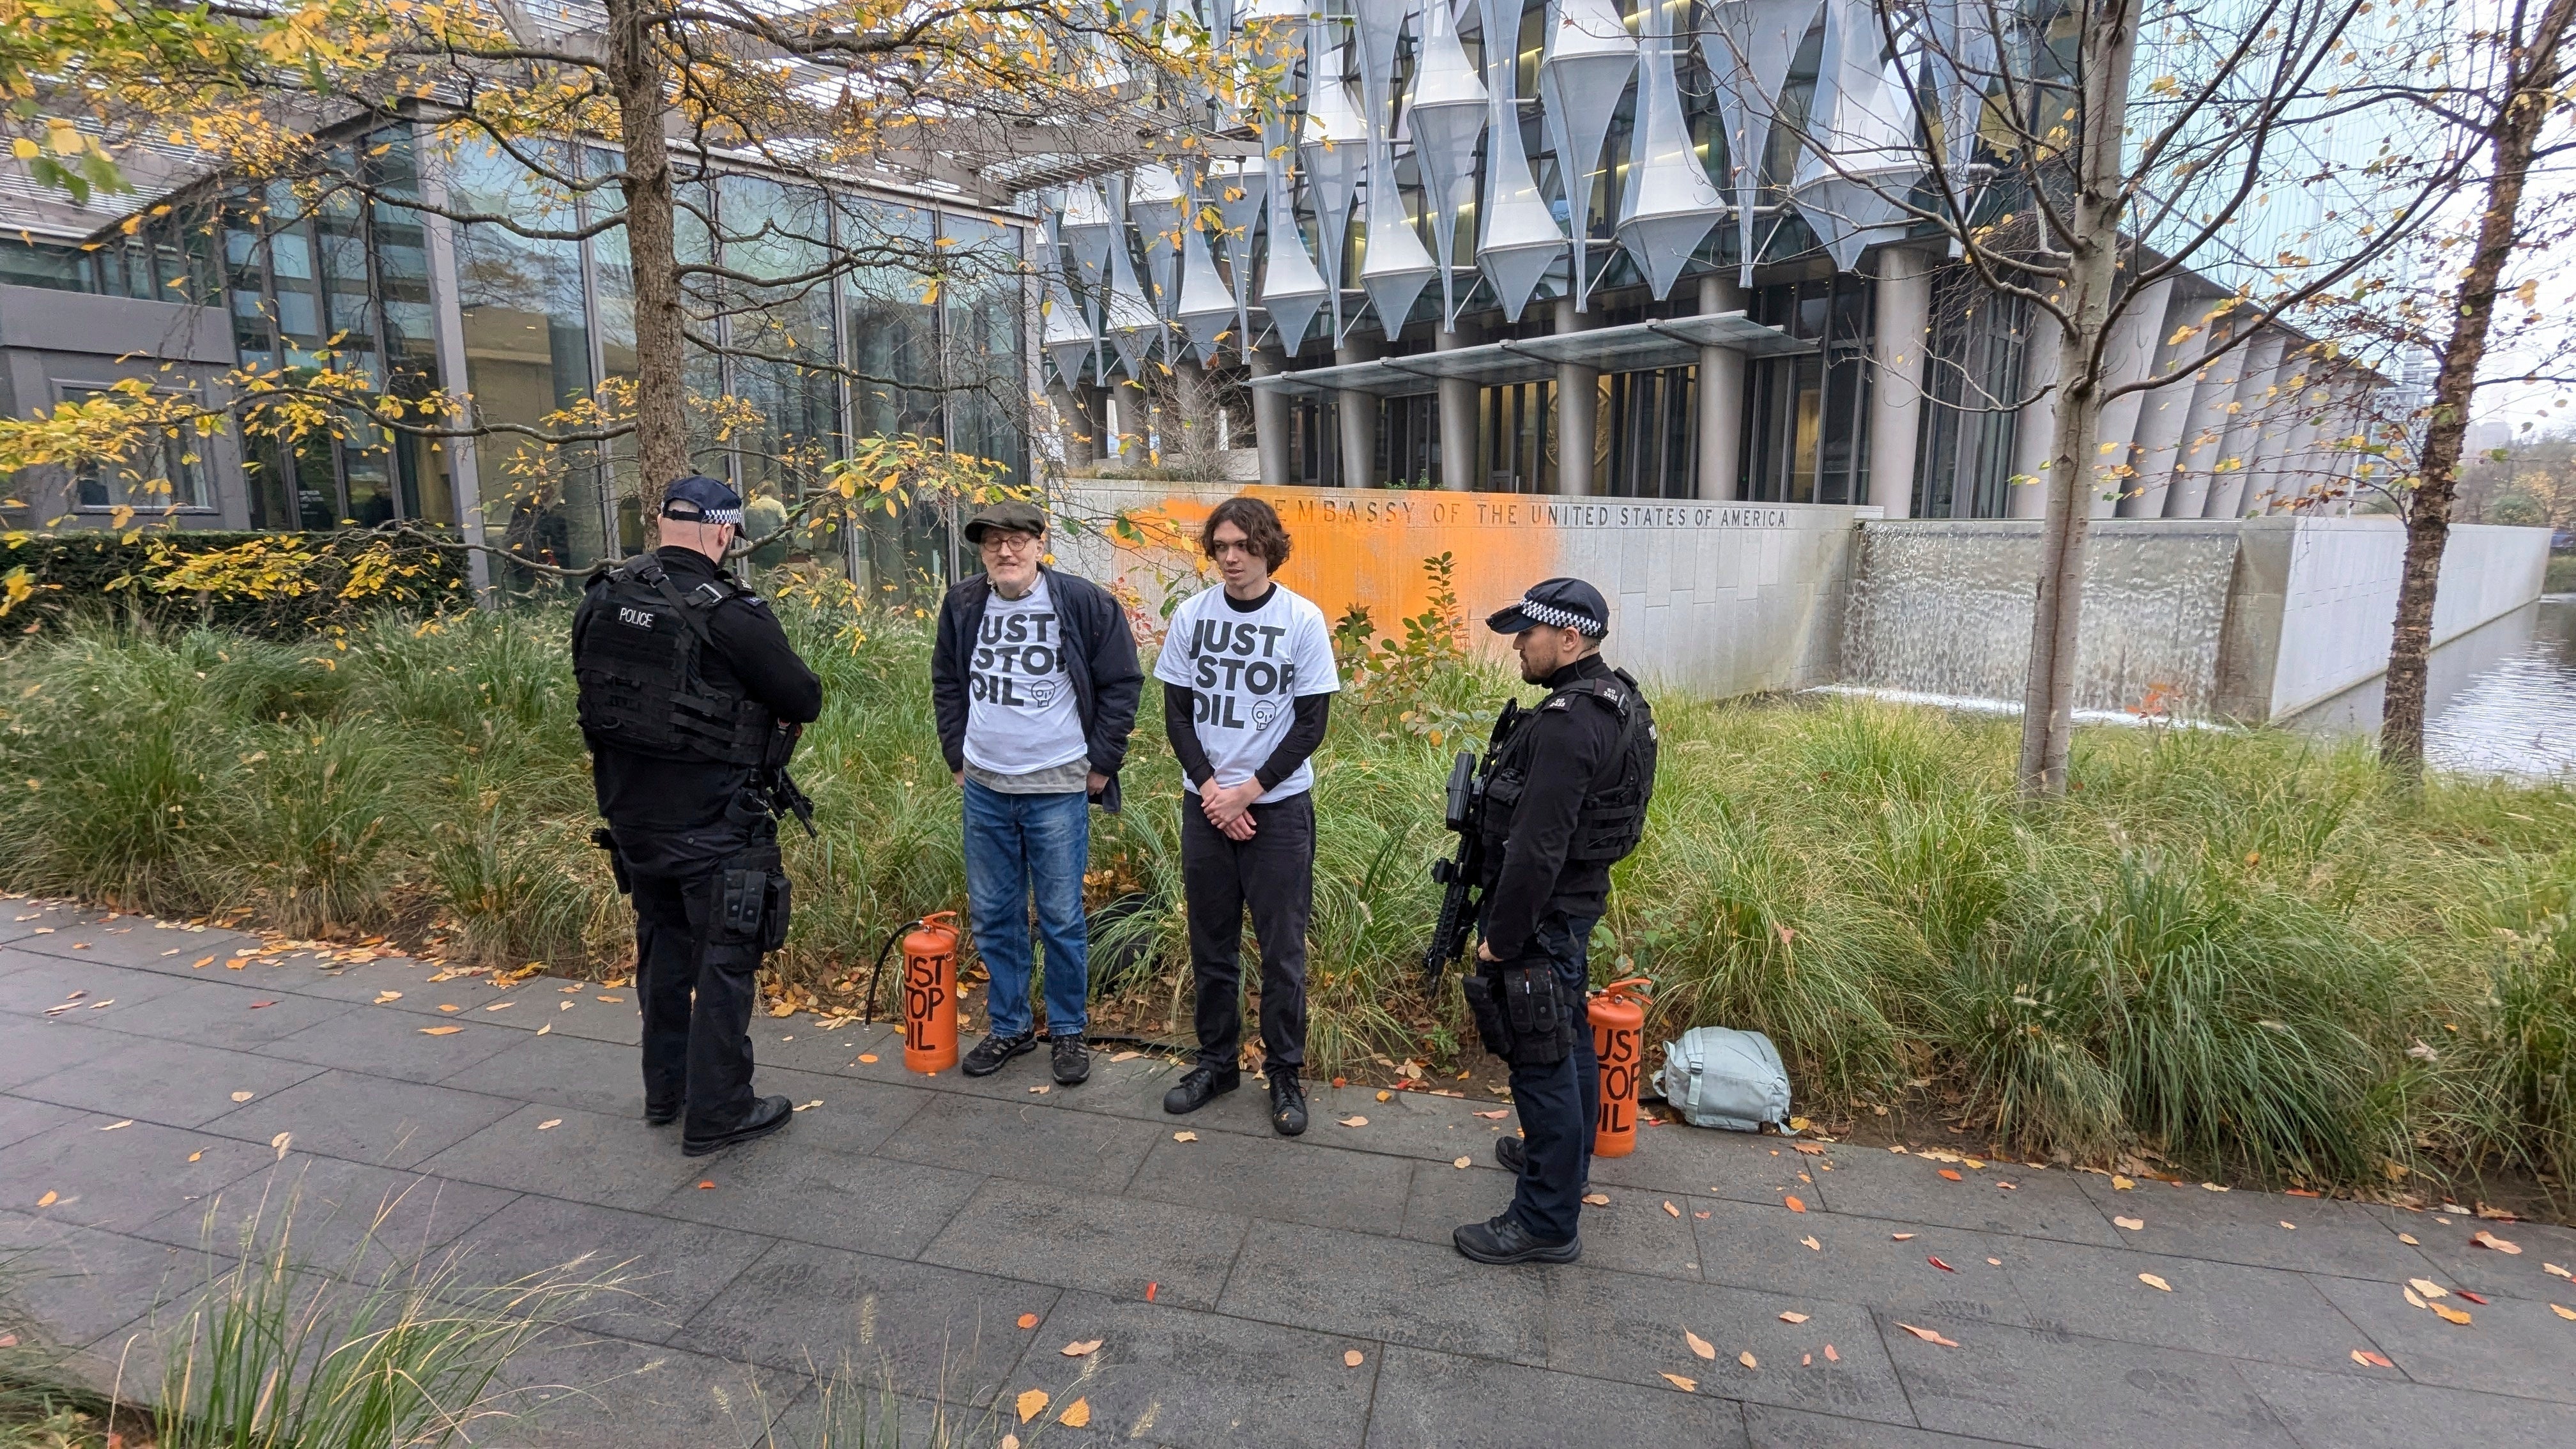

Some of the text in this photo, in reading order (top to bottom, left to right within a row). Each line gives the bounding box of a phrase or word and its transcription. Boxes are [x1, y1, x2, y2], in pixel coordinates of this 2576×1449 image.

[1275, 499, 1786, 528] EMBASSY OF THE UNITED STATES OF AMERICA
[618, 607, 654, 628] POLICE
[979, 613, 1055, 645] UST
[1189, 618, 1287, 660] JUST
[969, 670, 1024, 707] OIL
[1195, 654, 1295, 696] STOP
[1192, 689, 1245, 730] OIL
[904, 954, 946, 988] UST
[904, 983, 946, 1022] TOP
[1591, 1025, 1641, 1062] UST
[1597, 1061, 1641, 1101] TOP
[1597, 1103, 1630, 1133] IL
